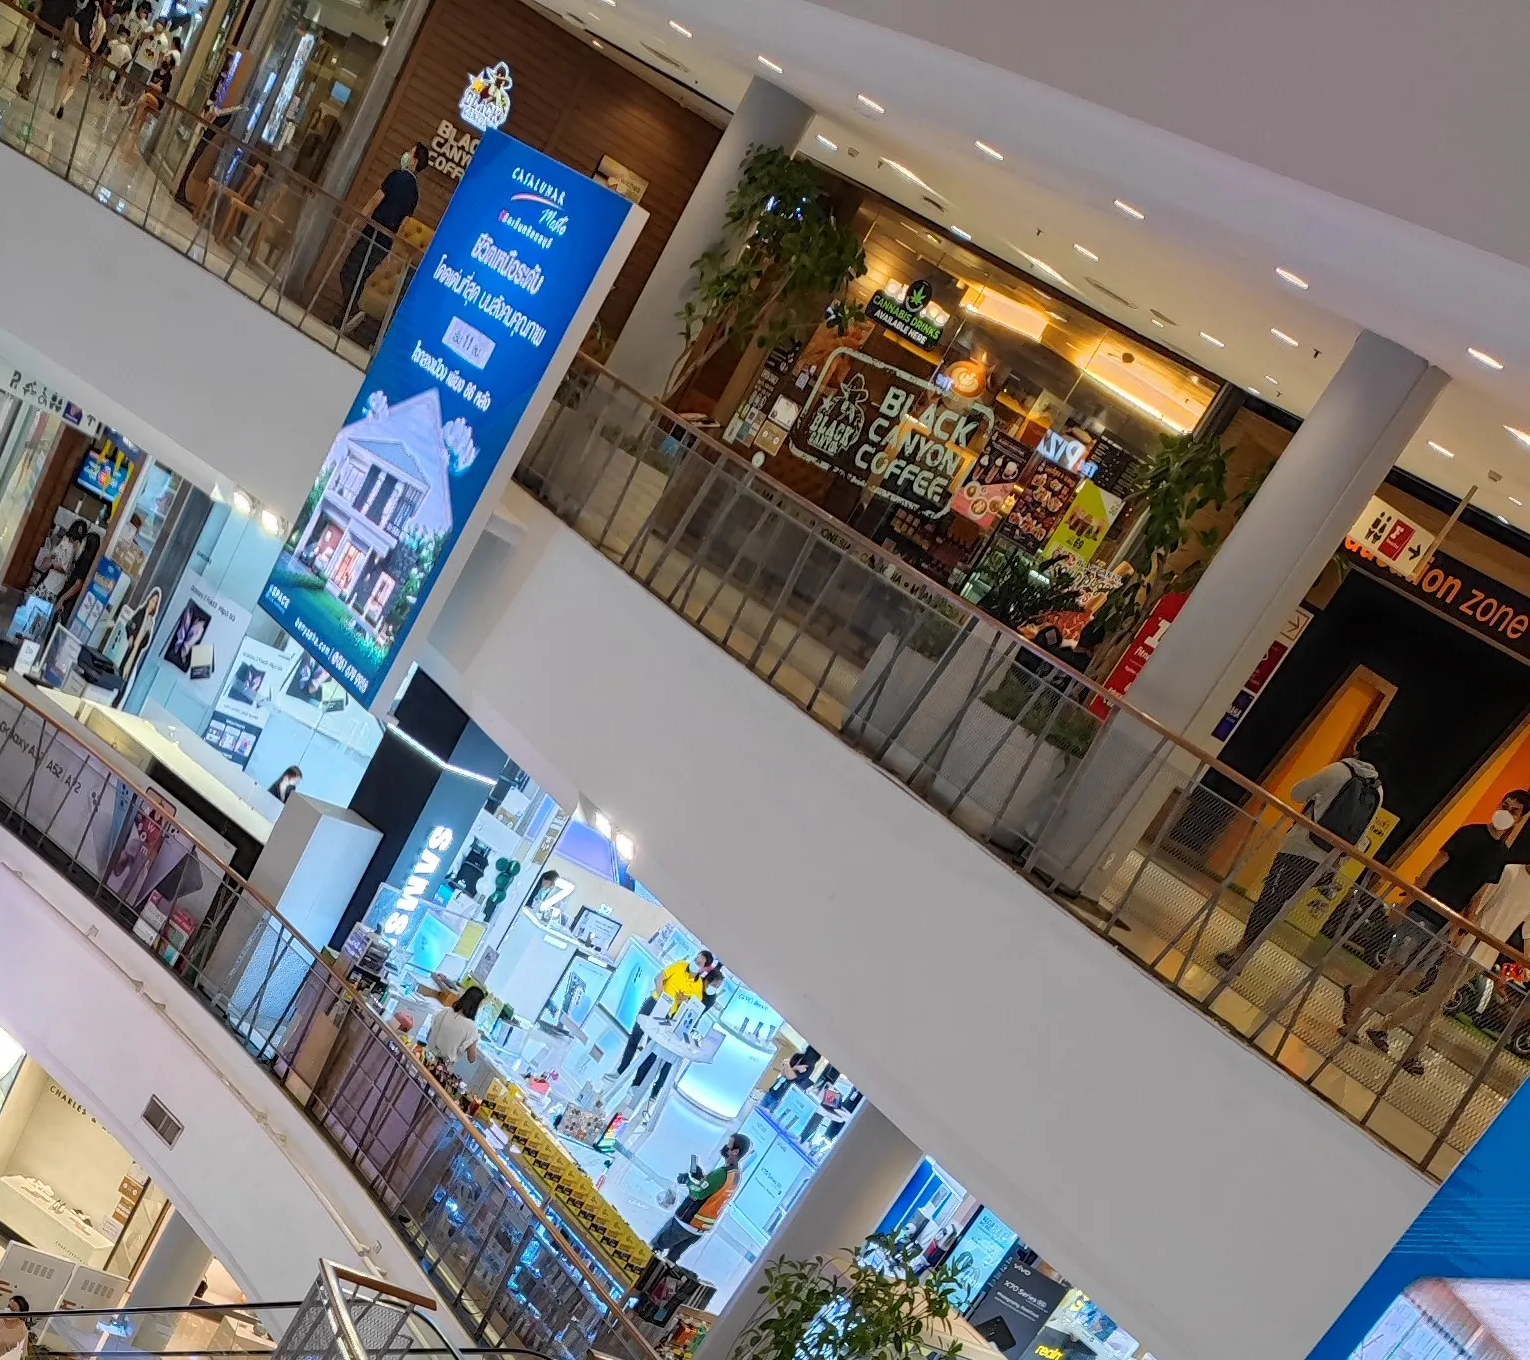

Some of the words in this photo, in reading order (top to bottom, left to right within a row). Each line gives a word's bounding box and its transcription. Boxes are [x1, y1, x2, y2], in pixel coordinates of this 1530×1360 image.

[872, 293, 914, 325] CANNABIS
[909, 315, 942, 340] DRINKS
[873, 309, 911, 336] AVAILABLE
[907, 329, 928, 346] HERE
[809, 413, 854, 447] BLACK
[879, 386, 979, 447] BLACK
[869, 418, 963, 475] CANYON
[855, 443, 949, 502] COFFEE
[1072, 537, 1085, 550] 69
[1459, 587, 1530, 640] zone
[46, 760, 64, 780] A52
[49, 1085, 88, 1117] CHARLES
[1013, 1262, 1032, 1276] vivo
[1003, 1279, 1019, 1295] X70
[1017, 1289, 1038, 1306] Series
